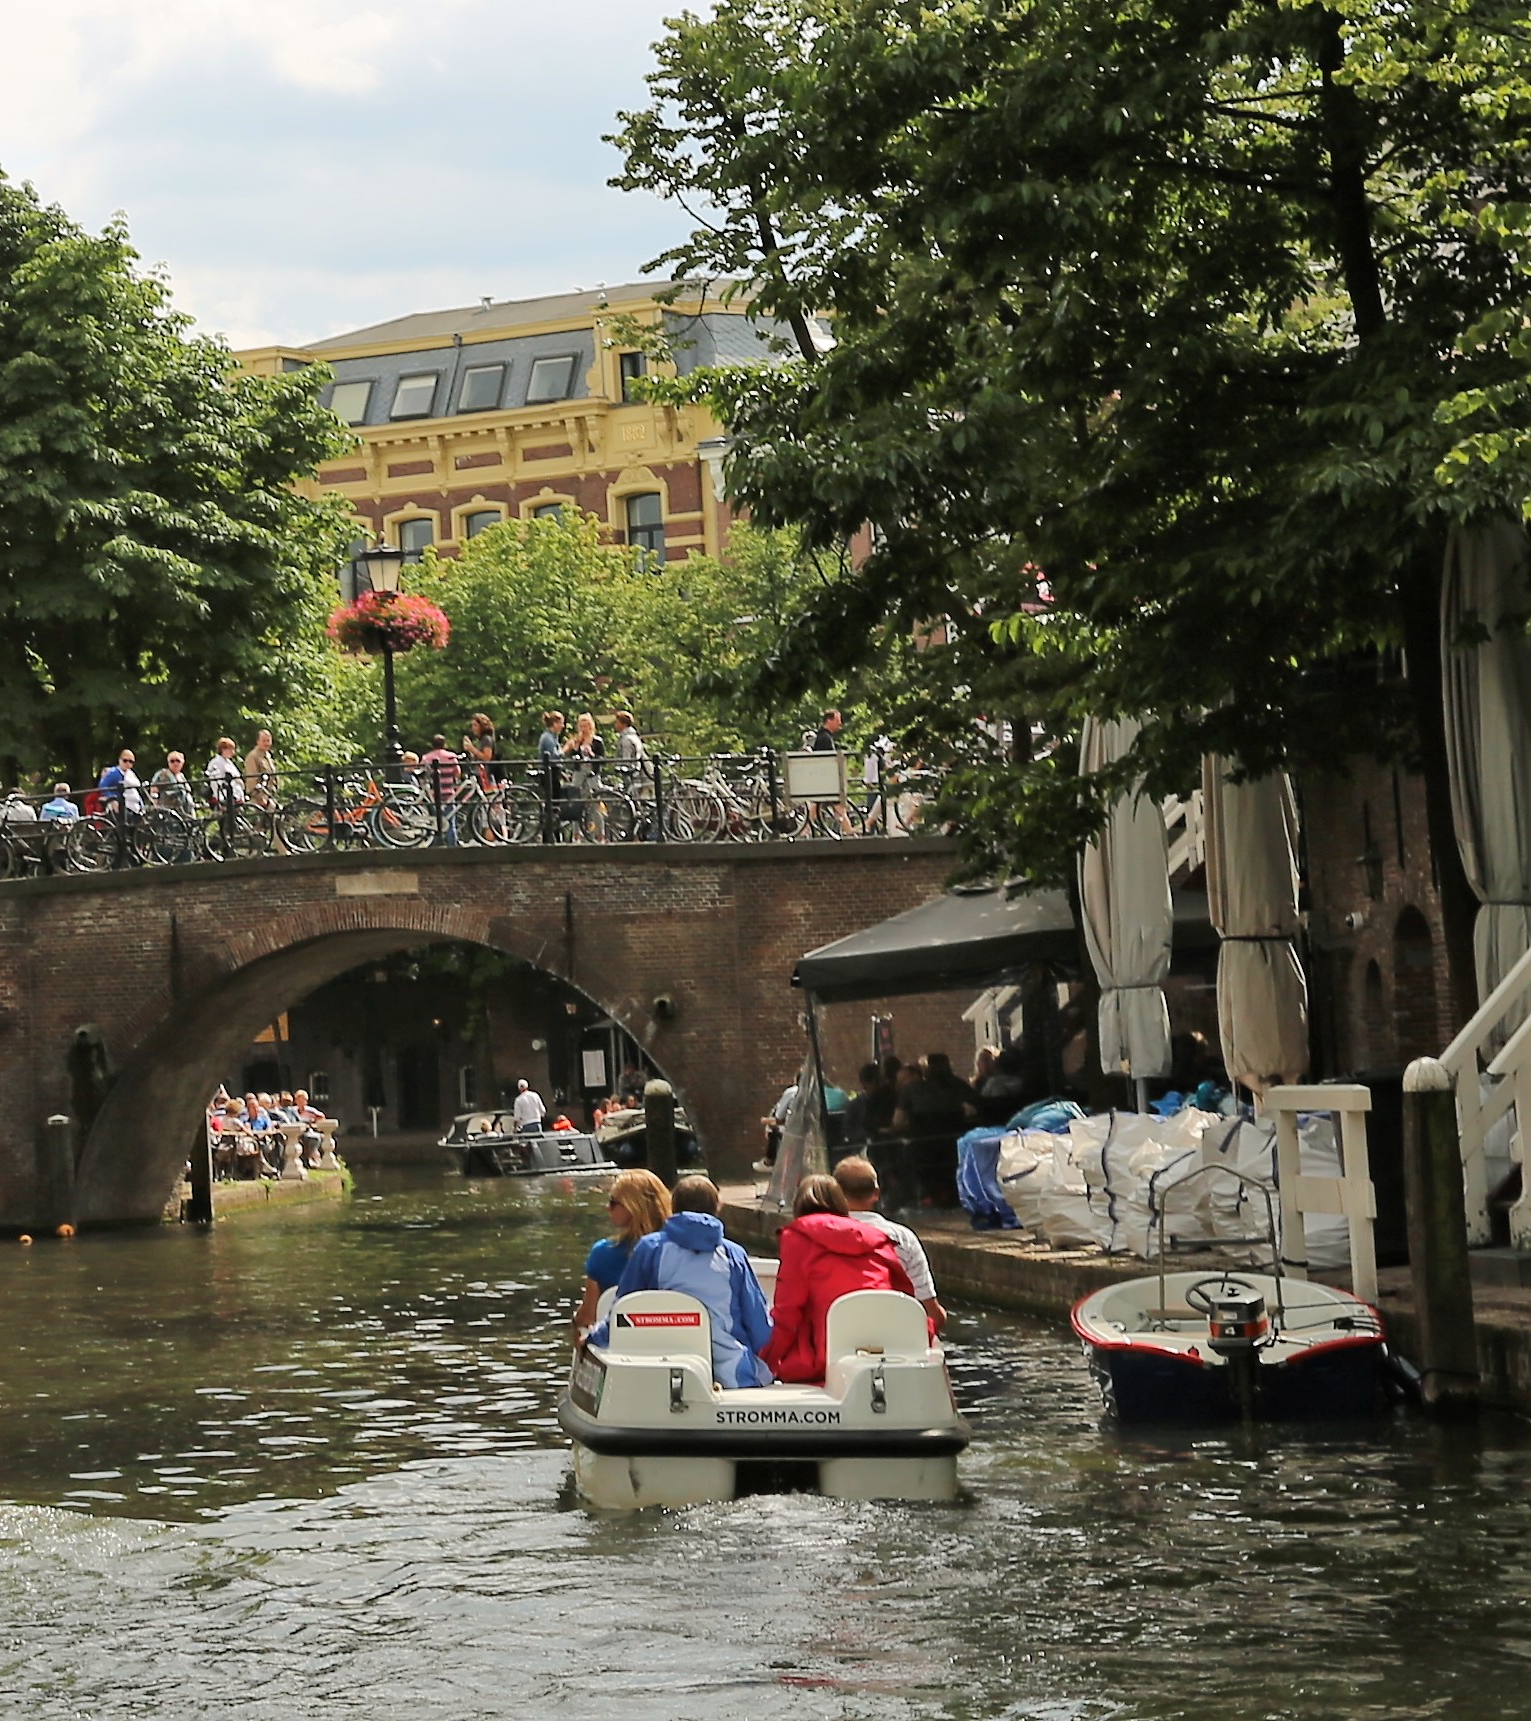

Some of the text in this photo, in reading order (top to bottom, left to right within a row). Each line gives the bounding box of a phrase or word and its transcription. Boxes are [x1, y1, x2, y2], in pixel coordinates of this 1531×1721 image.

[635, 1316, 696, 1325] STROMMA.COM
[1225, 1326, 1236, 1336] 4
[716, 1411, 841, 1424] STROMMA.COM
